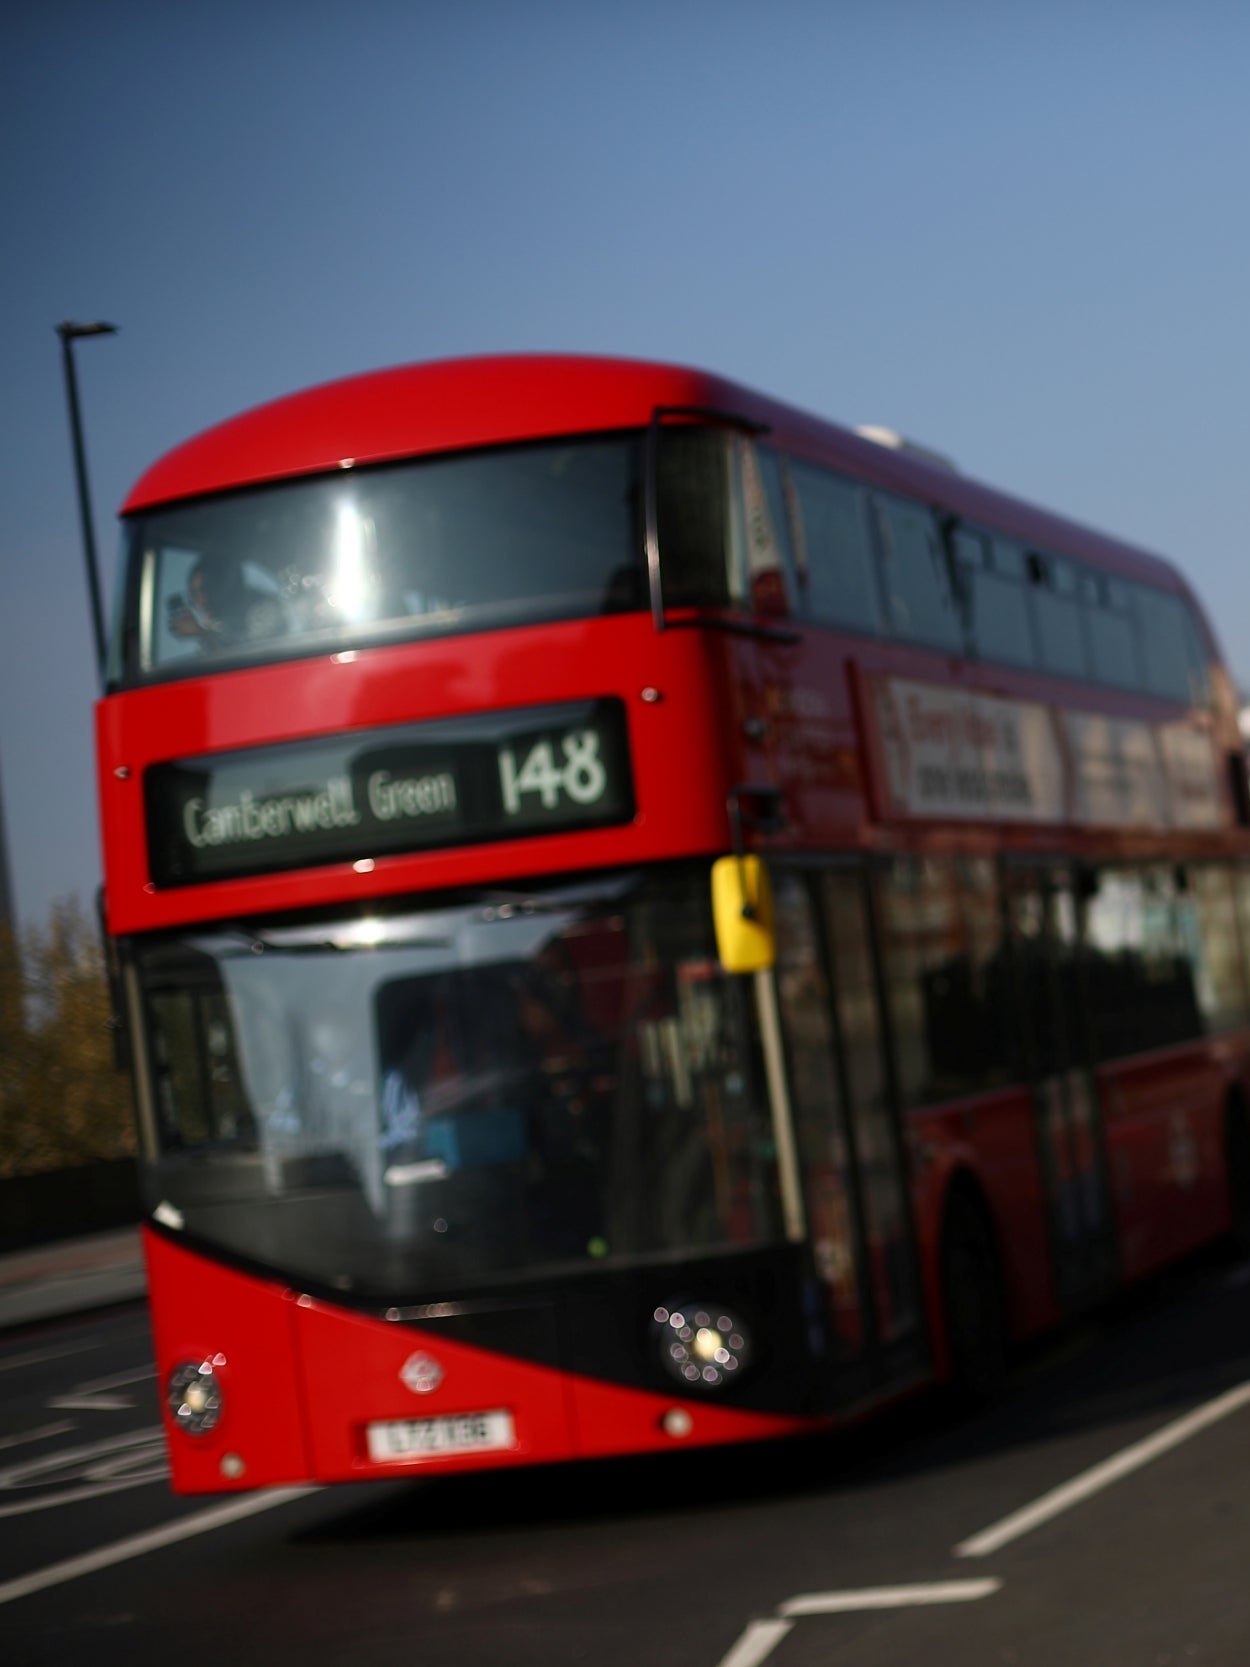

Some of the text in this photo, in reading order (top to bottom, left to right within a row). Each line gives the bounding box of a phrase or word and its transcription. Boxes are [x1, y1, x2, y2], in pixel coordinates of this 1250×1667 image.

[183, 727, 606, 848] Camberwell Green 148
